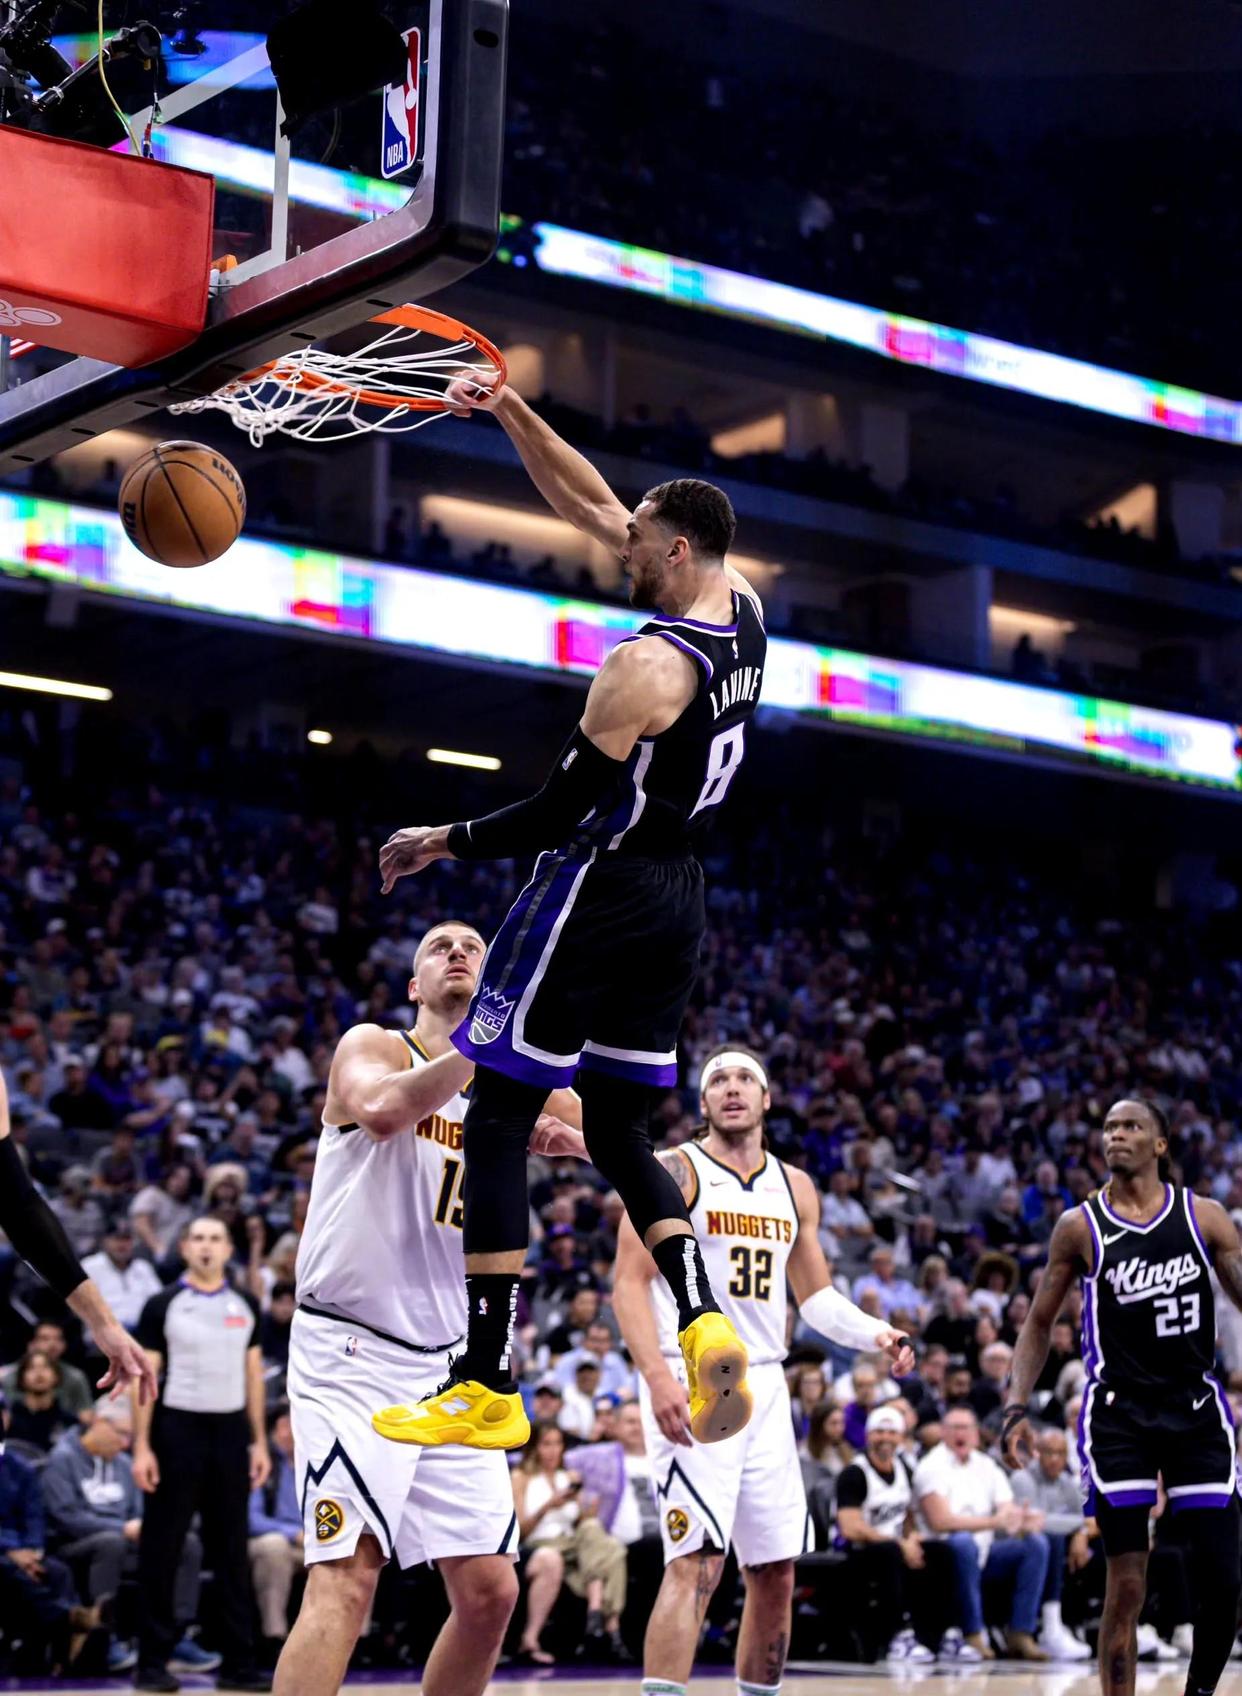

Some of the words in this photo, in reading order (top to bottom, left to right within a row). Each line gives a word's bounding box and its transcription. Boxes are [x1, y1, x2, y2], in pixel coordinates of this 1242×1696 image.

[386, 140, 404, 169] NBA
[709, 666, 761, 721] LAVINE
[687, 721, 745, 821] 8
[705, 1210, 793, 1245] NUGGETS
[728, 1245, 774, 1302] 32
[1104, 1252, 1201, 1305] Kings
[1153, 1292, 1201, 1338] 23
